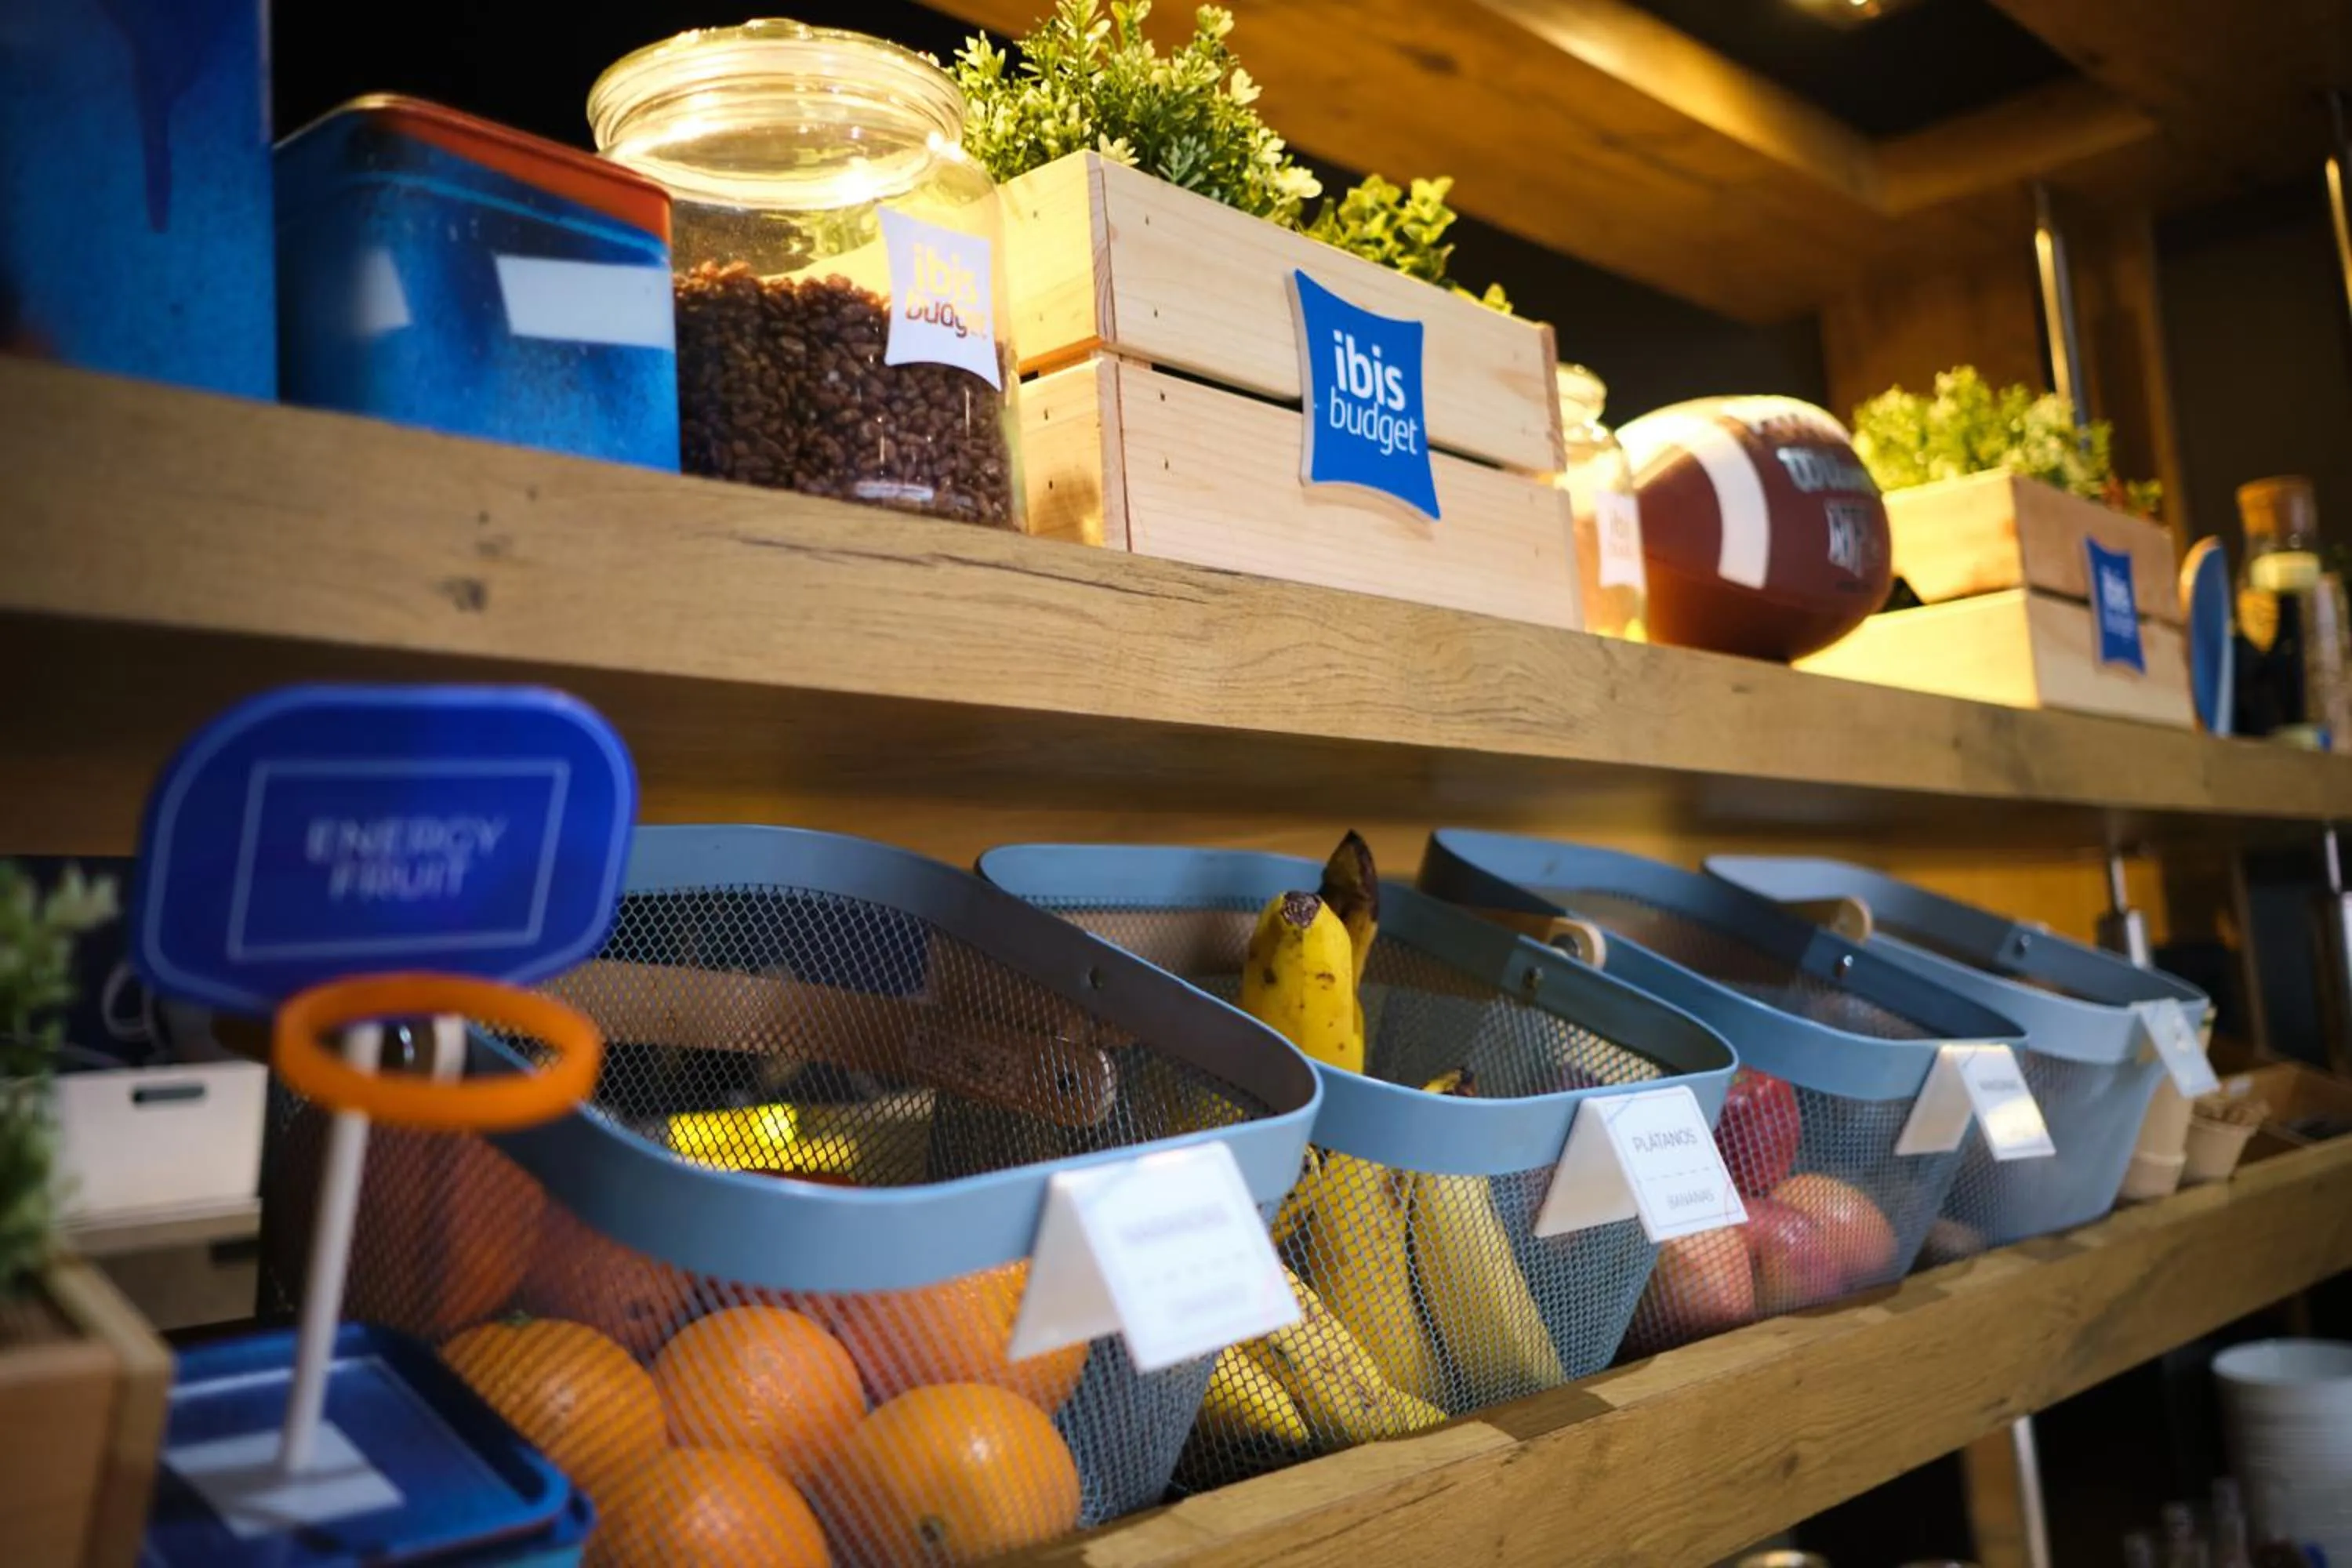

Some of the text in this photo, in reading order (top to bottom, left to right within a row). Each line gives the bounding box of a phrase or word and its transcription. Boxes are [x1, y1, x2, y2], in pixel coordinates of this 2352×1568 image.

[913, 242, 978, 307] ibis
[1333, 328, 1406, 412] ibis
[1330, 385, 1417, 456] budget
[307, 816, 508, 862] ENERGY
[328, 858, 466, 902] FRUIT
